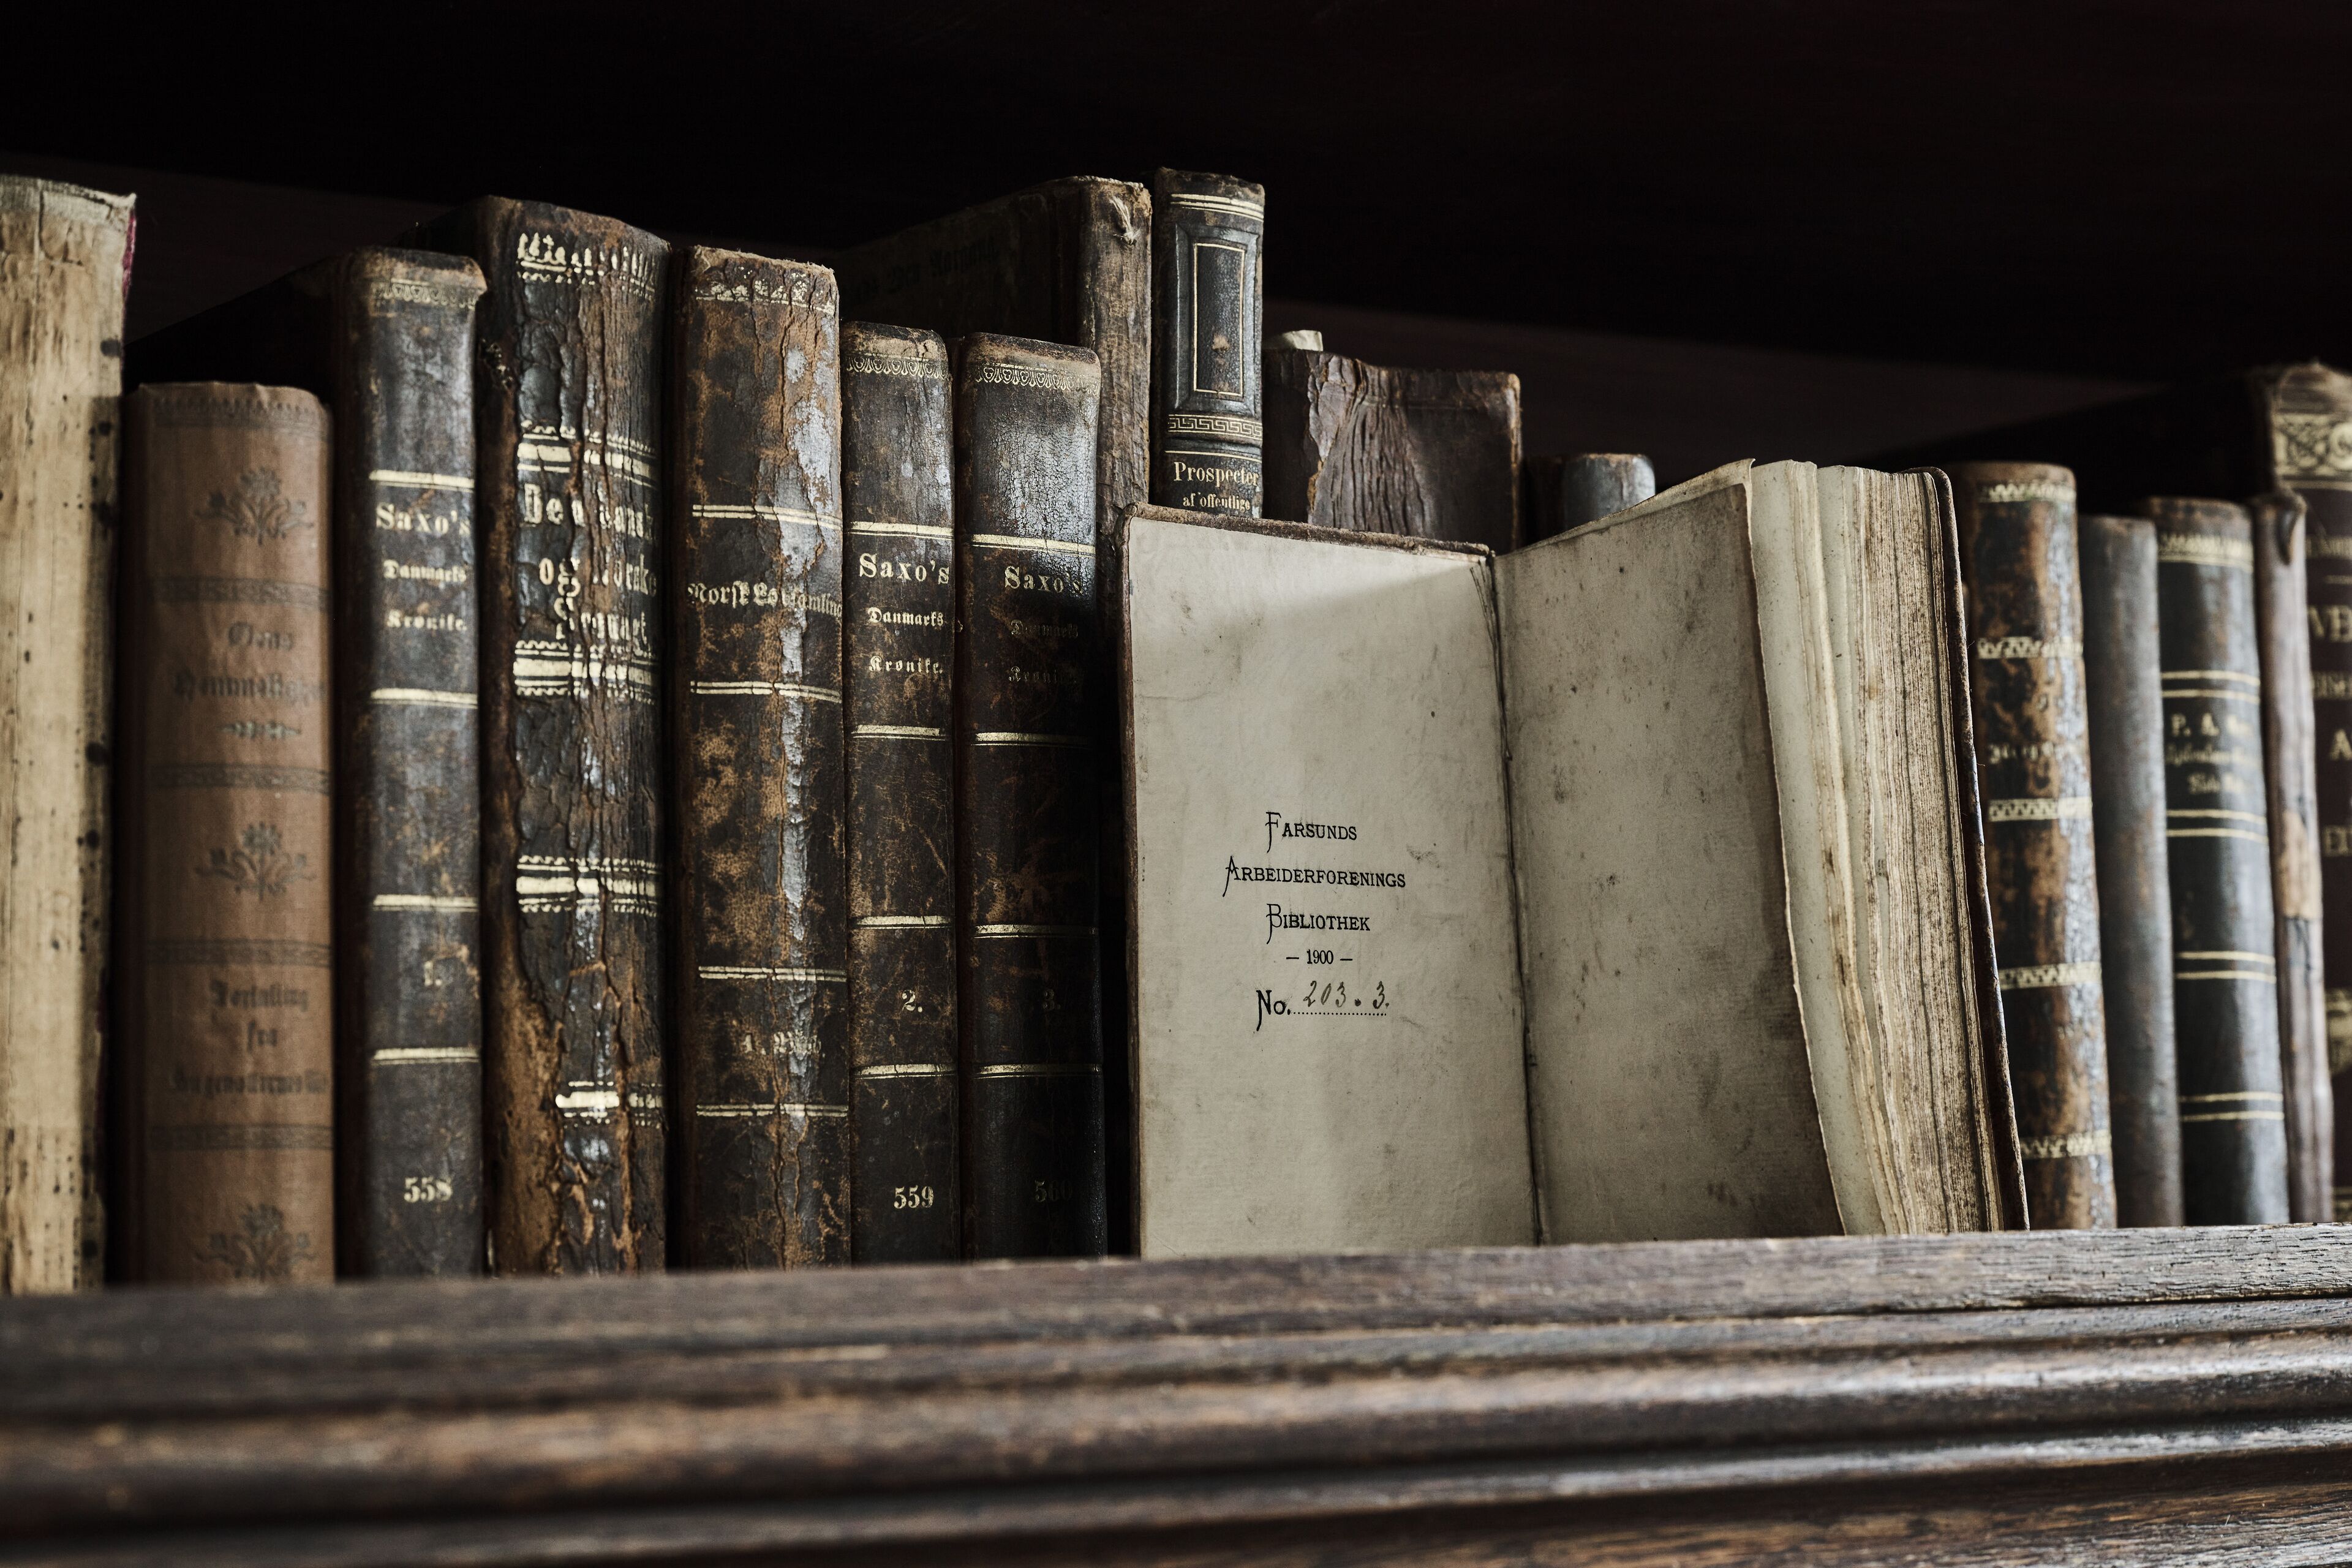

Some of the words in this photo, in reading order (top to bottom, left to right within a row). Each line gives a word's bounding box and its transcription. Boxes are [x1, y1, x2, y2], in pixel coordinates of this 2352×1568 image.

[1174, 461, 1259, 488] Prospecter
[1200, 493, 1251, 513] offentlige
[376, 502, 471, 536] Saxo's
[859, 553, 949, 584] Saxo's
[1005, 565, 1083, 596] Saxo's
[867, 606, 944, 626] Danmarks
[1306, 949, 1334, 965] 1900
[902, 989, 923, 1013] 2.
[894, 1185, 934, 1209] 559
